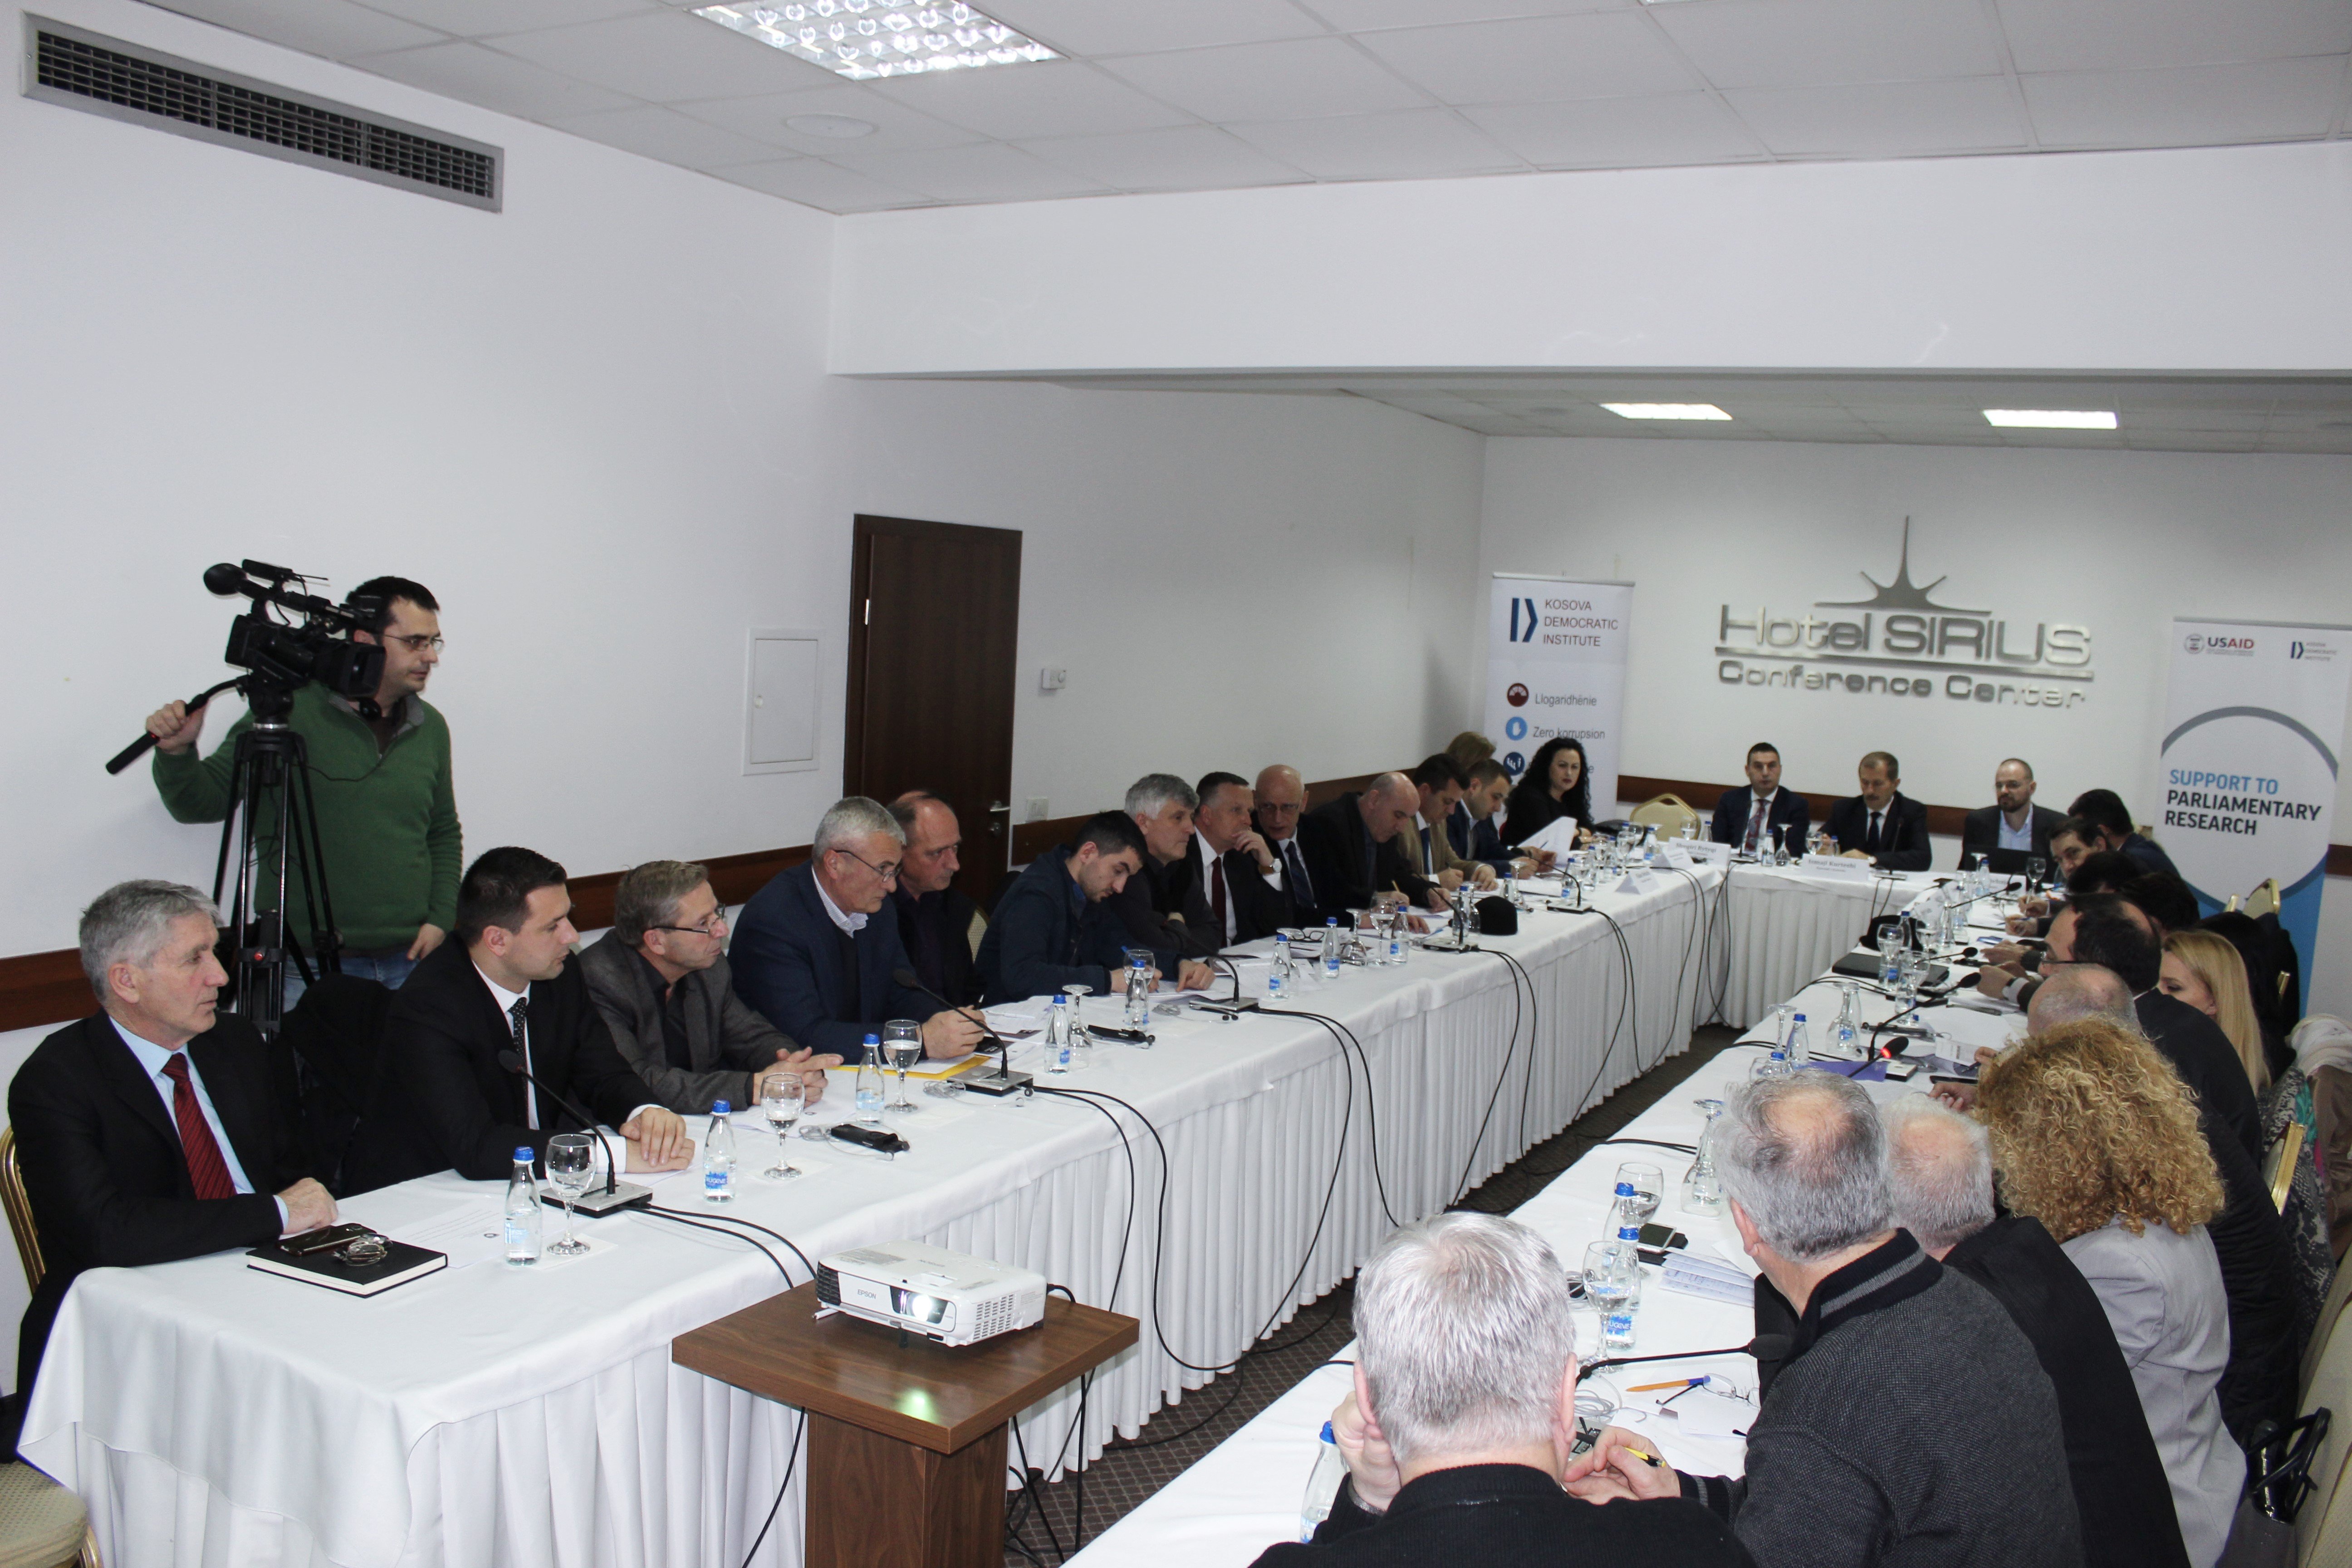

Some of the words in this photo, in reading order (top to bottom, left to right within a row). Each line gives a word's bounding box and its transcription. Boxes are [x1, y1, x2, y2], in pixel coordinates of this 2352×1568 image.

[1545, 599, 1592, 611] KOSOVA
[1544, 616, 1618, 630] DEMOCRATIC
[1544, 634, 1601, 647] INSTITUTE
[1720, 604, 1872, 651] Hotel
[1884, 613, 2092, 666] SIRIUS
[2208, 637, 2254, 649] USAID
[1718, 660, 1933, 697] Conference
[1945, 675, 2086, 709] Center
[1533, 726, 1554, 738] Zero
[1557, 728, 1605, 740] korrupsion
[2170, 769, 2251, 792] SUPPORT
[2256, 777, 2279, 794] TO
[2167, 789, 2322, 821] PARLIAMENTARY
[2165, 810, 2258, 835] RESEARCH
[858, 1289, 877, 1299] EPSON
